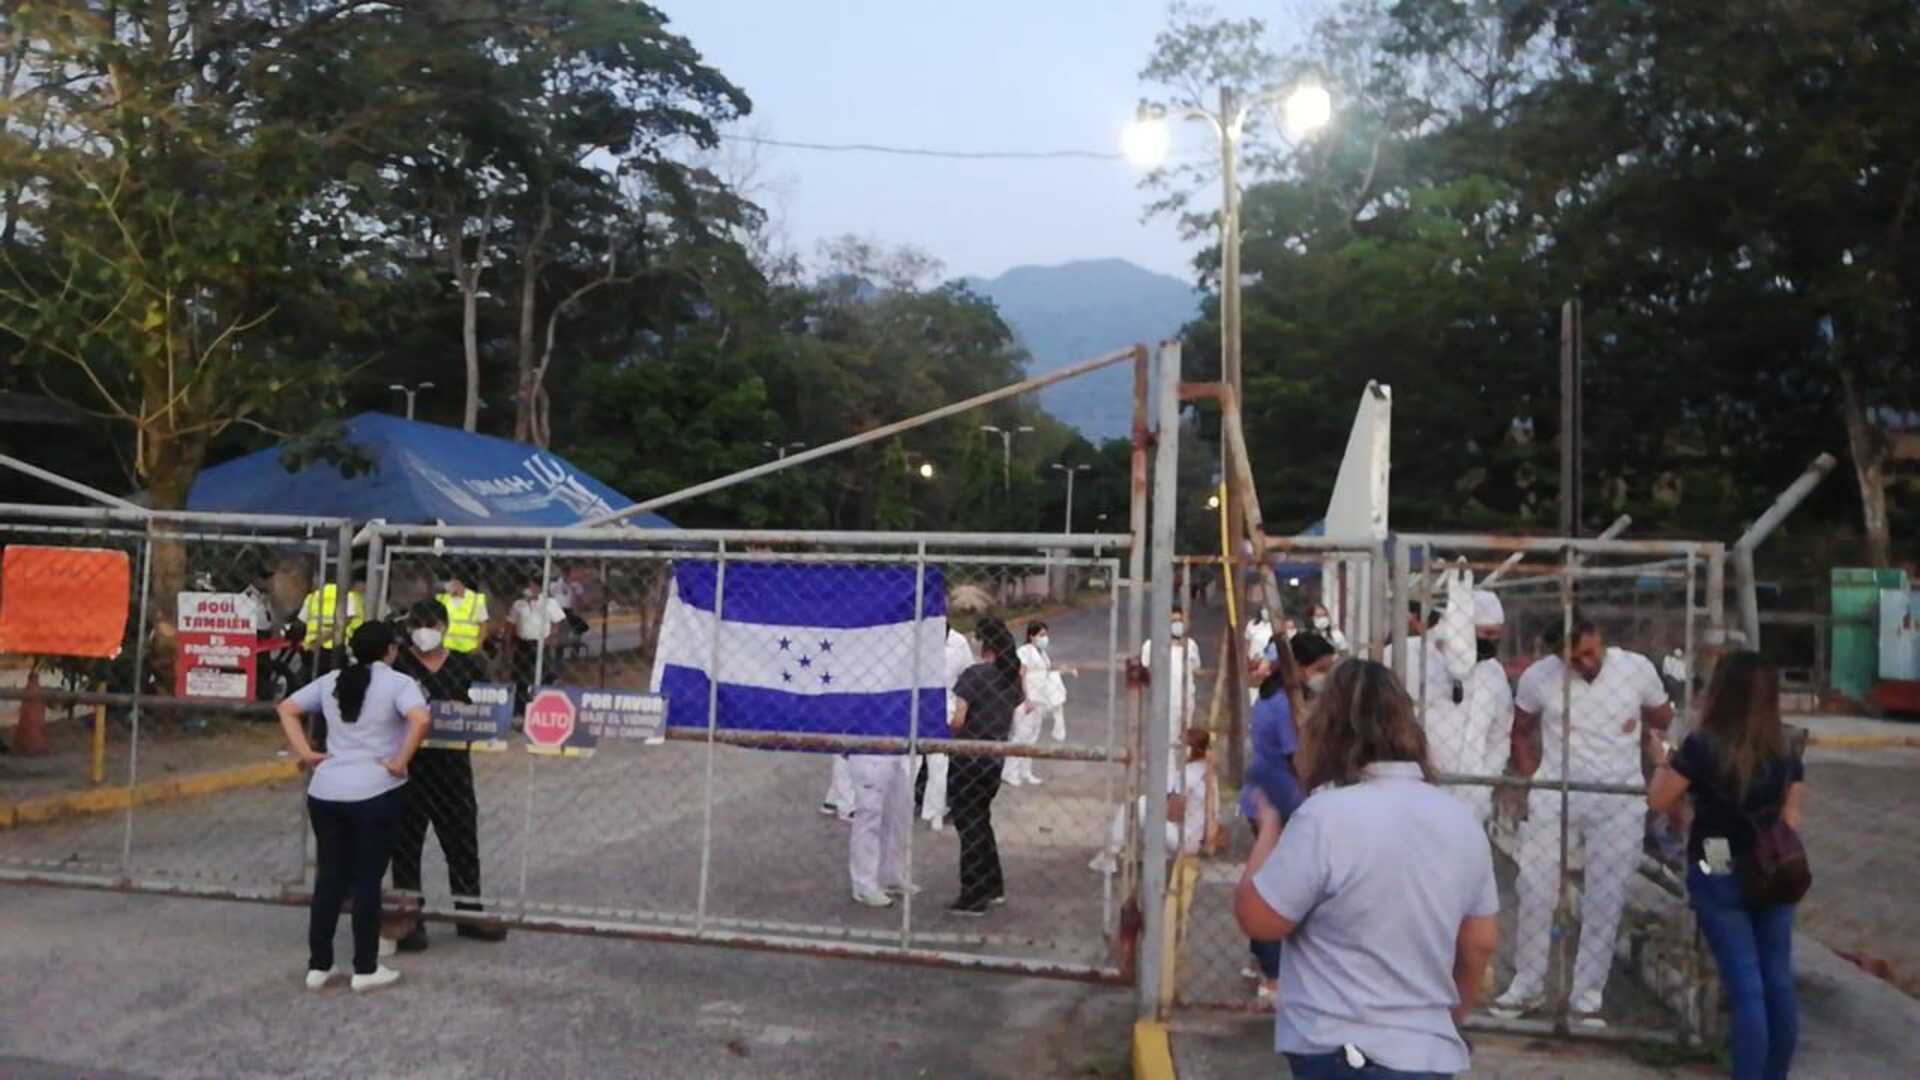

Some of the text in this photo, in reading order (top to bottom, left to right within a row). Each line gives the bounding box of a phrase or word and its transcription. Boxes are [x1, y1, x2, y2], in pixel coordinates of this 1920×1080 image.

[197, 597, 235, 614] AQUÍ
[183, 613, 251, 629] TAMBIÉN
[581, 692, 663, 713] POR FAVOR
[530, 711, 569, 728] ALTO
